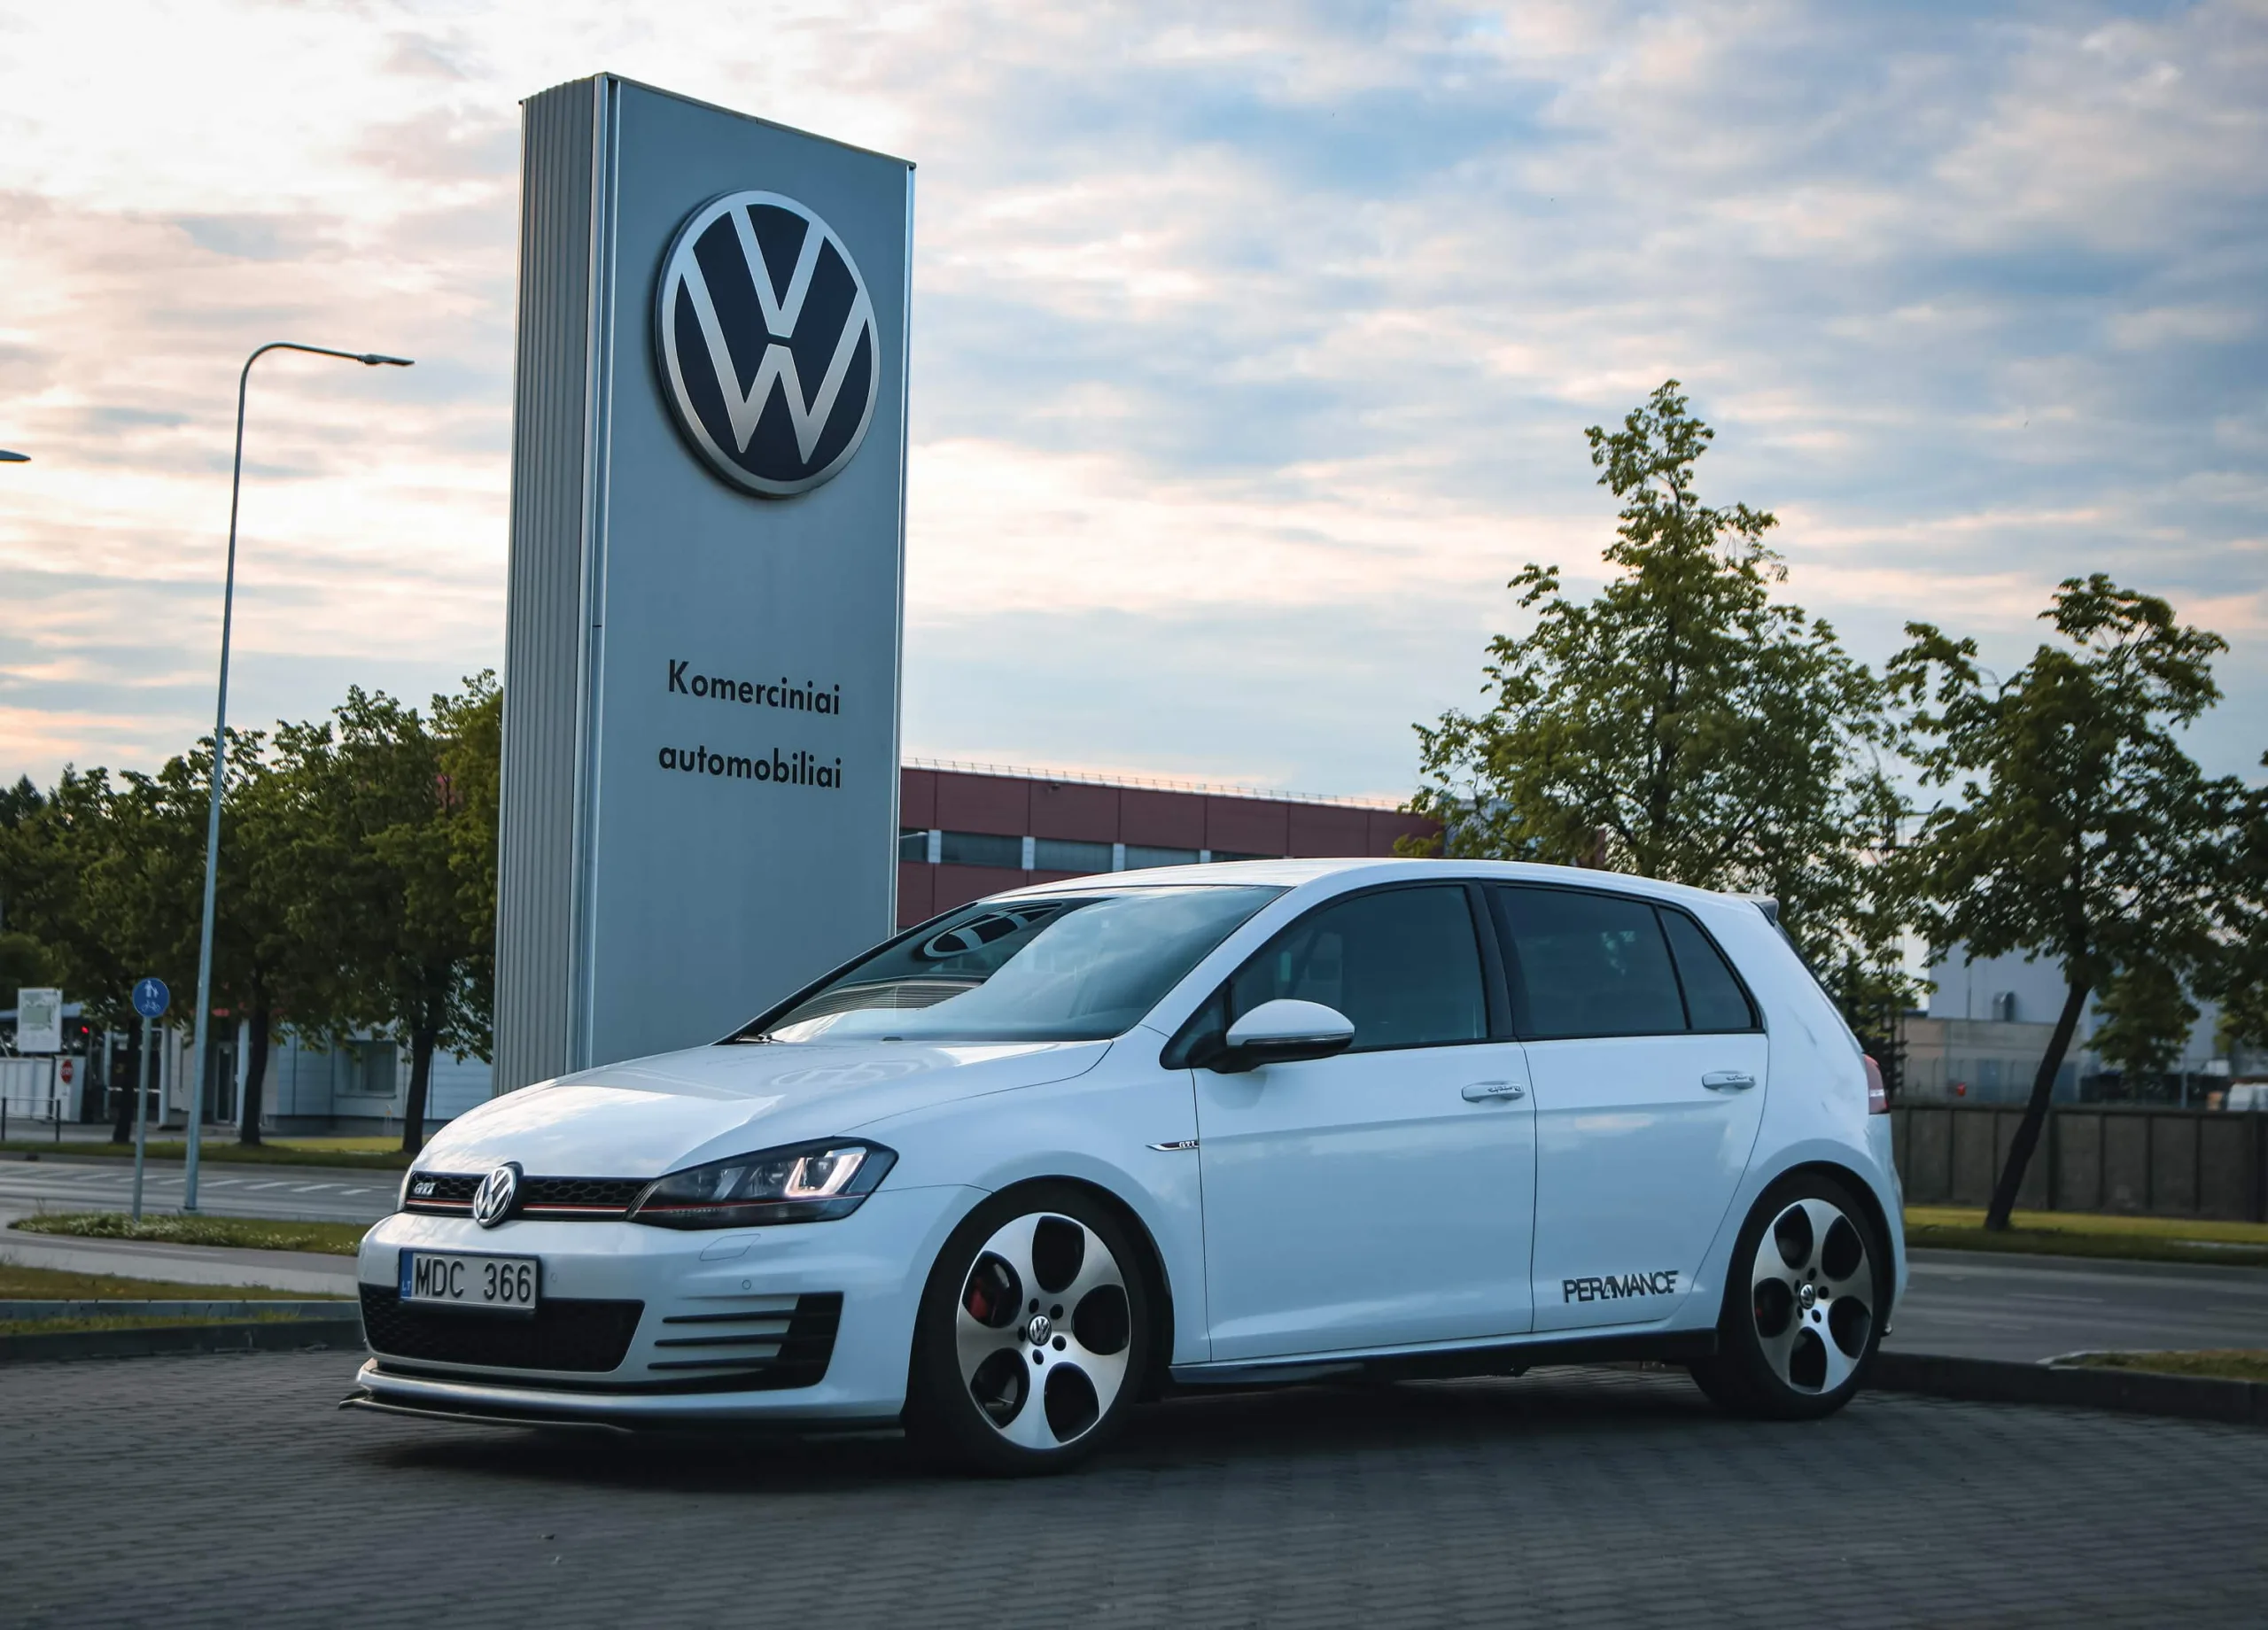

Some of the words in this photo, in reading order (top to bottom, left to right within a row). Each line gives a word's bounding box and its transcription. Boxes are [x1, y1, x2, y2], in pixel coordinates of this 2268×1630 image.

[664, 197, 874, 470] VW
[668, 659, 840, 715] Komerciniai
[658, 745, 841, 788] automobiliai
[414, 1182, 436, 1195] GTI
[475, 1167, 516, 1225] VW
[401, 1280, 411, 1292] LT
[415, 1257, 465, 1299] MDC
[484, 1262, 532, 1303] 366
